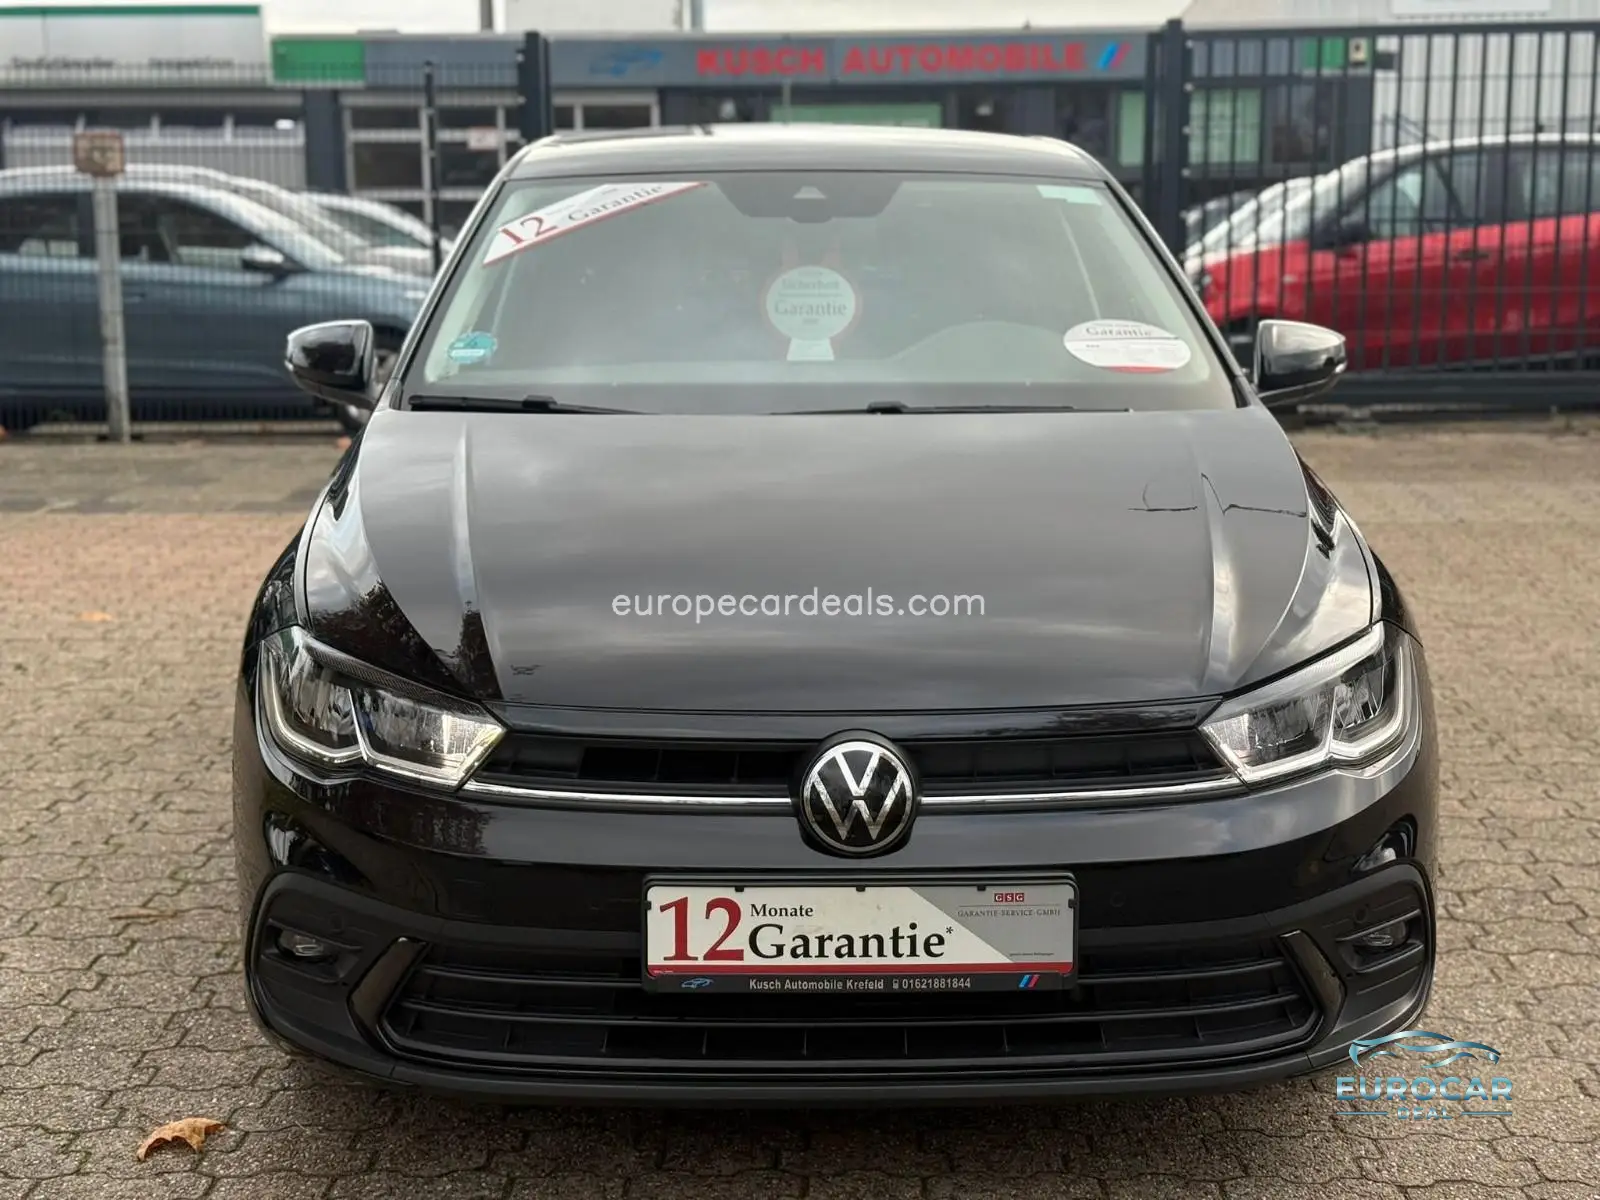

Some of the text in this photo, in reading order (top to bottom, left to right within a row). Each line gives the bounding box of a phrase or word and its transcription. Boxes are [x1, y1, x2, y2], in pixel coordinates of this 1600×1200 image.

[697, 42, 1088, 76] KUSCH AUTOMOBILE
[567, 185, 665, 222] Garantie
[500, 215, 559, 246] 12
[750, 903, 814, 918] Monate
[994, 893, 1025, 903] GSG
[659, 896, 745, 962] 12
[749, 977, 971, 990] Kusch Automobile Krefeld 01621881844
